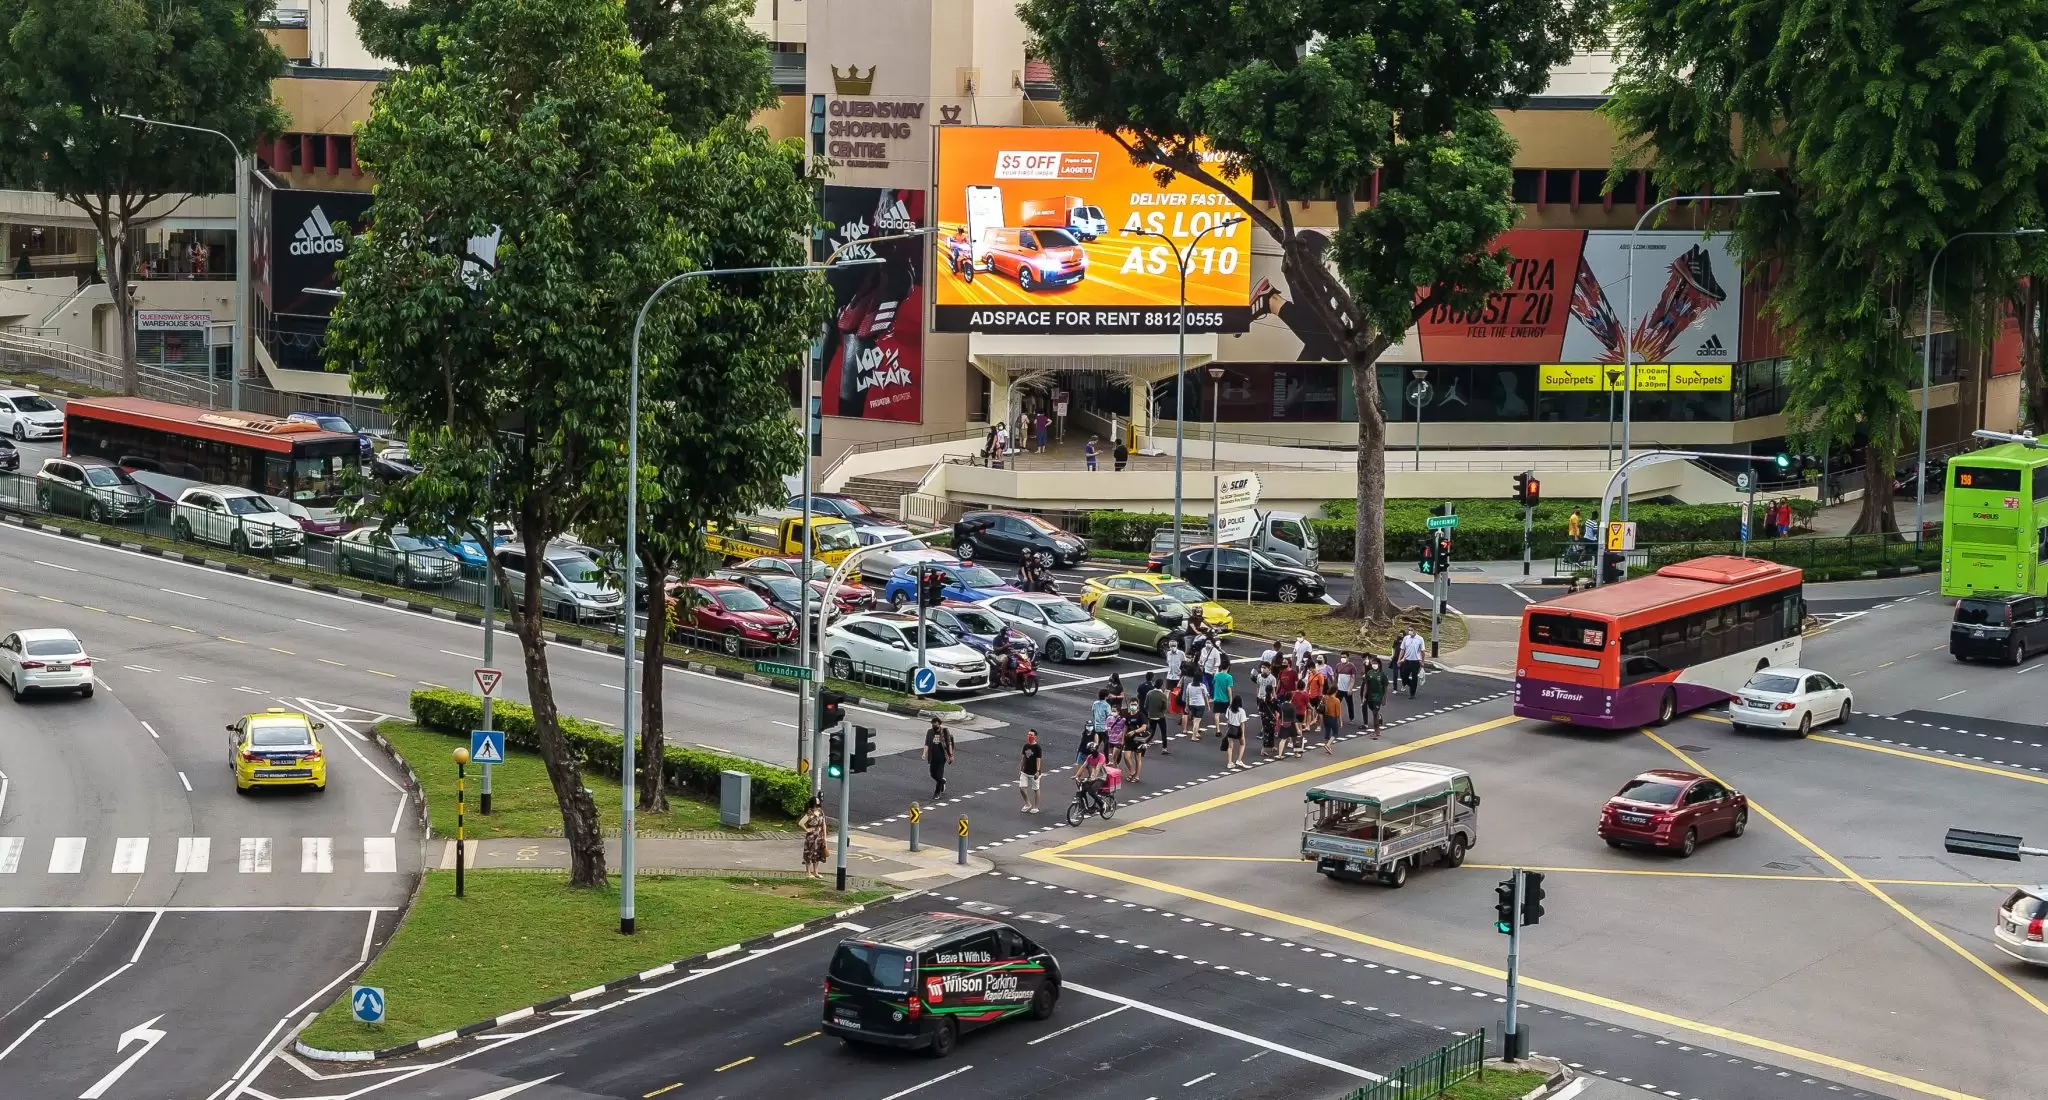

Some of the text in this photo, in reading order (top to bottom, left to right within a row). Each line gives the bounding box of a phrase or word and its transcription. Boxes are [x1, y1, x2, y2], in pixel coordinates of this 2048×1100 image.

[829, 100, 924, 118] QUEENSWAY
[829, 120, 911, 139] SHOPPING
[829, 140, 886, 158] CENTRE
[1002, 155, 1056, 169] $5 OFF
[1129, 192, 1237, 206] DELIVER FASTE
[880, 217, 916, 230] adidas
[1120, 211, 1242, 238] AS LOW
[290, 236, 343, 256] adidas
[1120, 243, 1239, 277] AS $10
[1503, 258, 1555, 291] TRA
[1520, 293, 1554, 325] 20
[970, 312, 1223, 326] ADSPACE FOR RENT 8812 0555
[1467, 327, 1547, 338] FEEL THE ENERGY
[1697, 349, 1727, 357] adidas
[857, 367, 912, 392] UNFAIR
[1228, 516, 1245, 526] POLICE
[758, 663, 810, 678] Alexandra Rd
[1541, 686, 1584, 702] SBS Transit
[936, 951, 991, 964] Leave It With Us
[943, 972, 1018, 992] Wilson Parking
[984, 989, 1035, 1002] Rapid Response
[839, 1019, 861, 1029] Wilson
